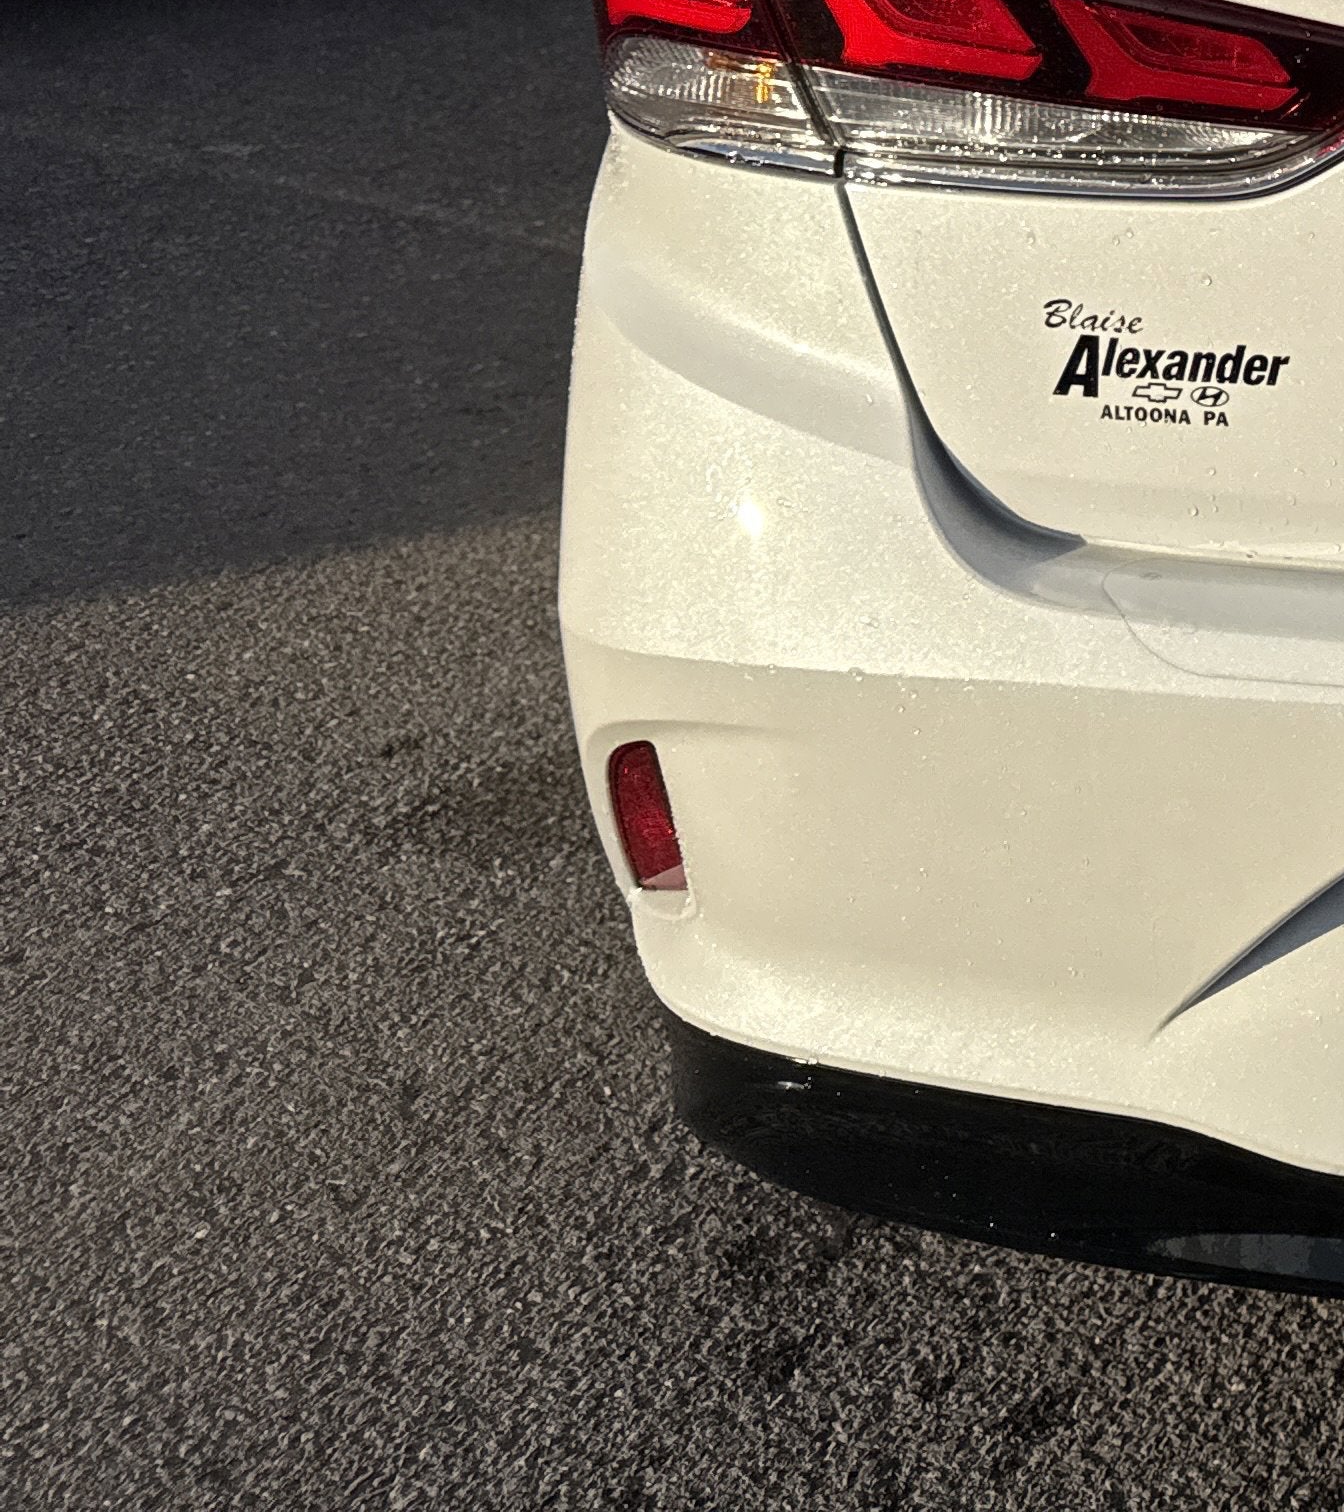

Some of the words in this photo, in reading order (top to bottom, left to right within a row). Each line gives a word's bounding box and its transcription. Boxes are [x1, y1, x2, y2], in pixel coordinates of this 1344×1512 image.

[1043, 298, 1145, 334] Blaise
[1053, 334, 1290, 398] Alexander
[1100, 405, 1192, 425] ALTOONA
[1203, 411, 1229, 427] PA
